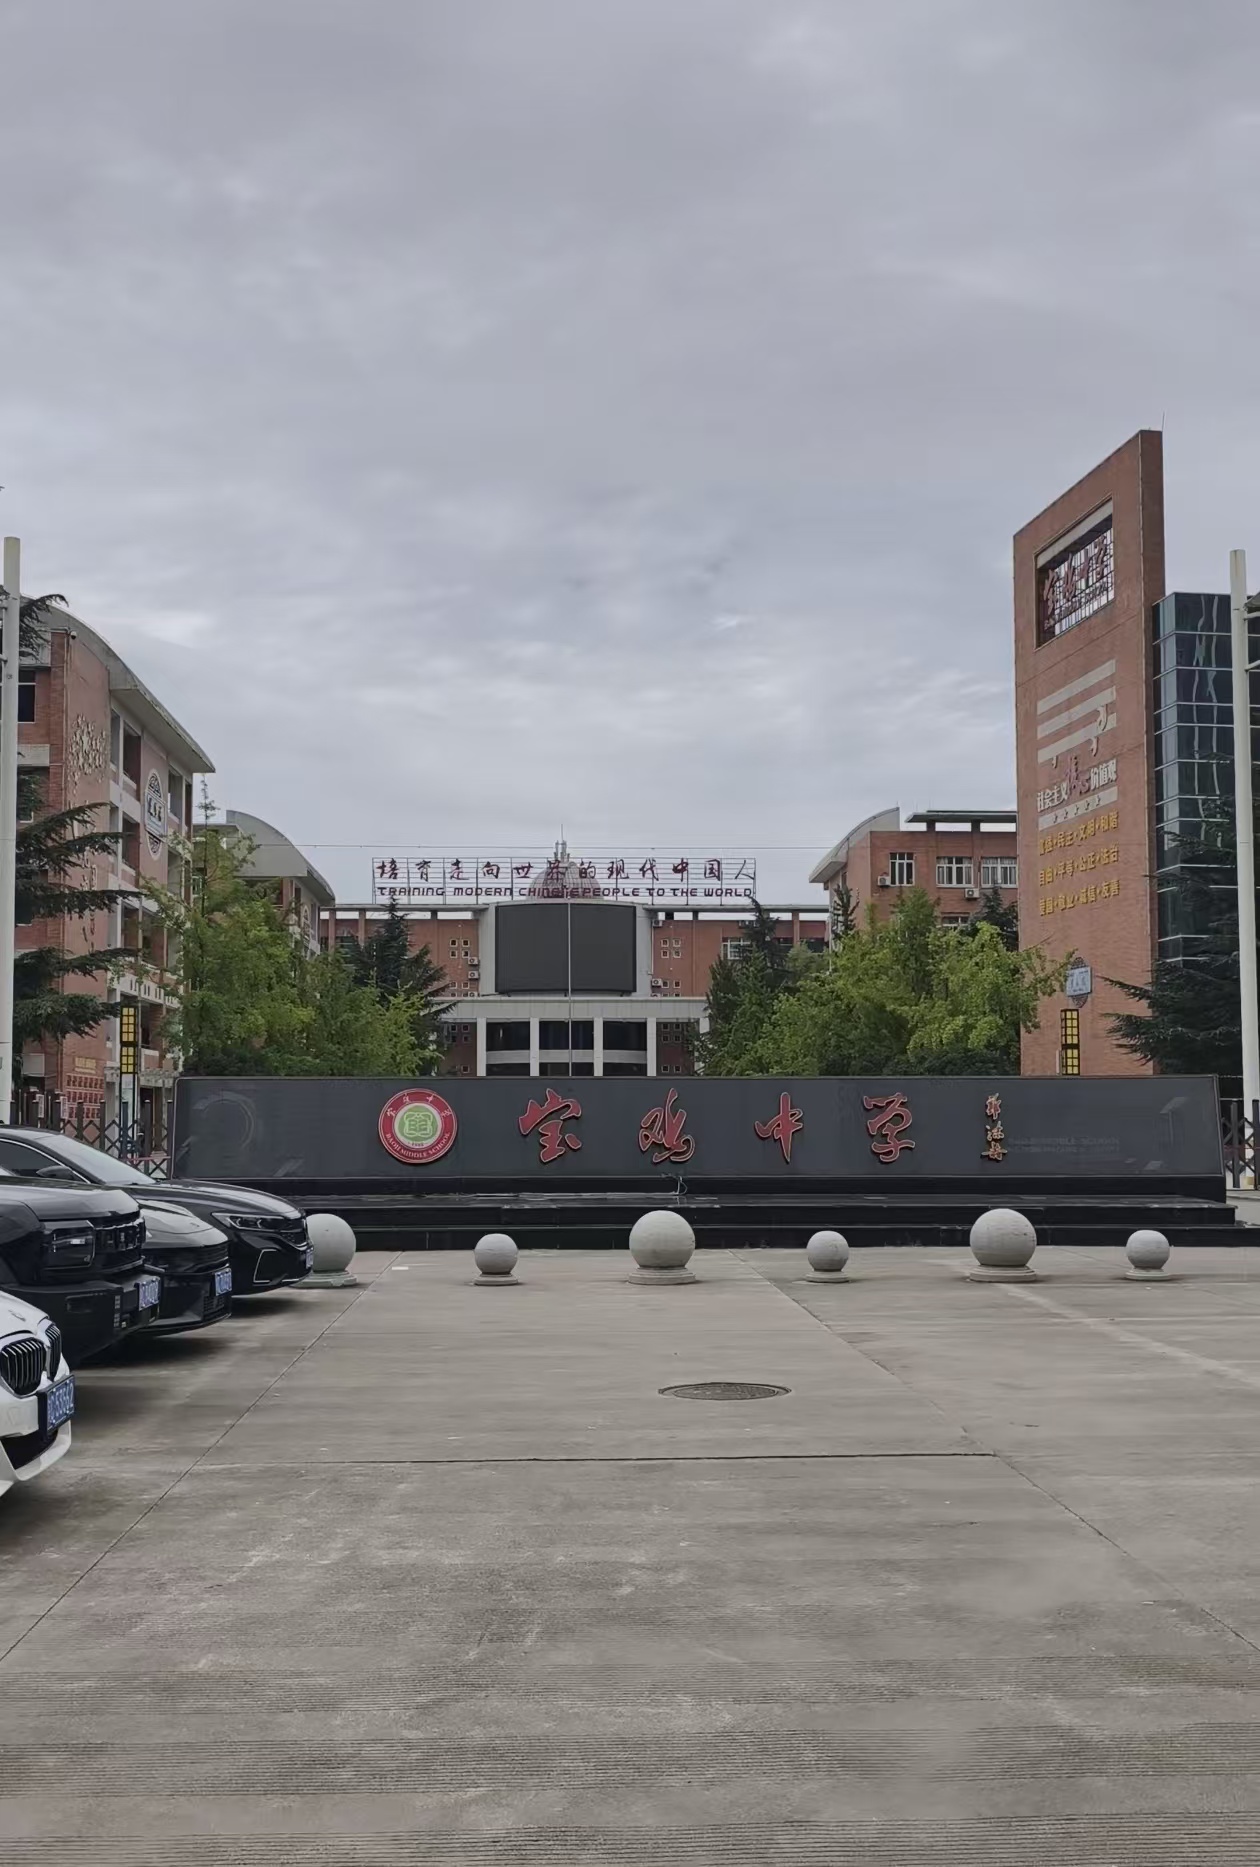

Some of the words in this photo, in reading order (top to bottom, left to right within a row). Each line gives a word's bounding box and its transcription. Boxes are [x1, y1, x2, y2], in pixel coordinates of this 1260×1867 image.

[376, 857, 756, 882] 培育走向世界的现代中国人
[377, 886, 445, 897] TRAINING
[453, 886, 514, 897] MODERN
[582, 886, 640, 897] PEOPLE
[646, 886, 665, 897] TO
[672, 886, 698, 897] THE
[704, 886, 752, 897] WORLD
[518, 1087, 916, 1165] 宝鸡中学
[428, 1133, 451, 1155] SCHOOL
